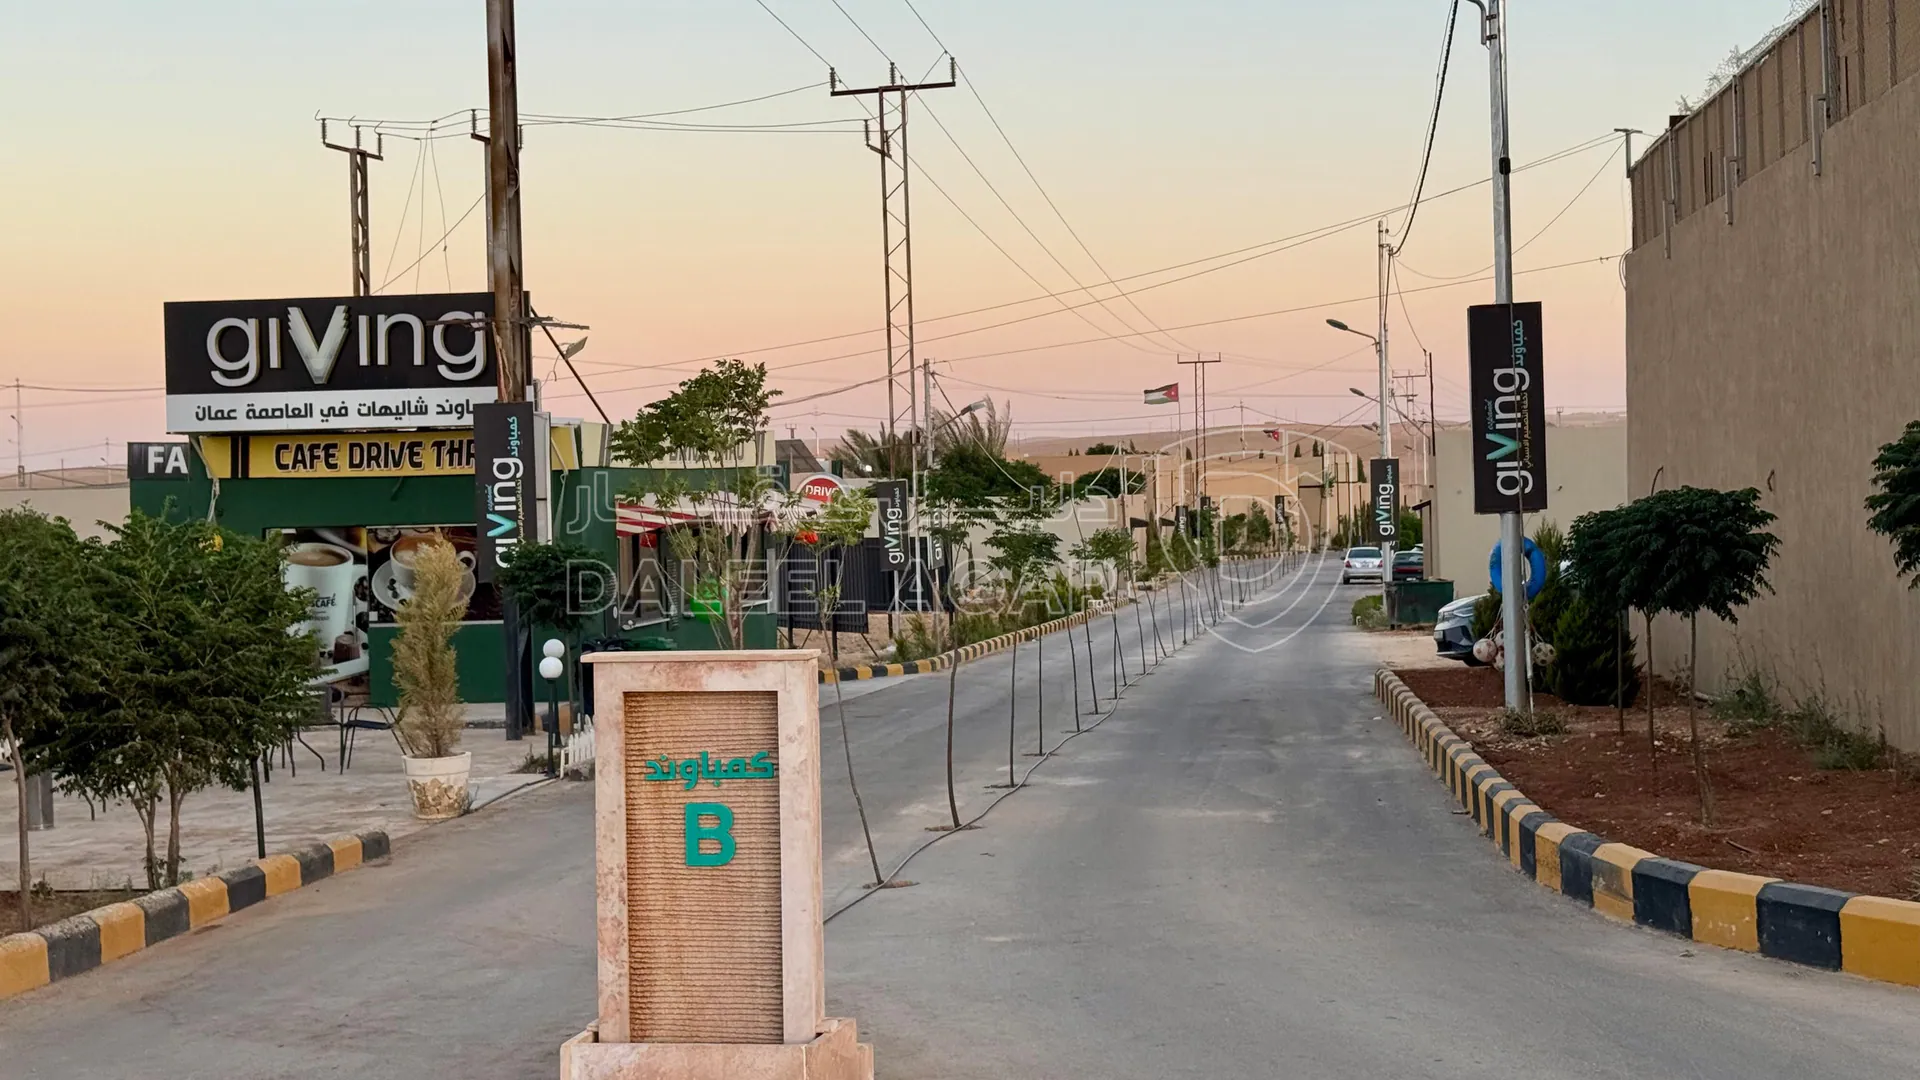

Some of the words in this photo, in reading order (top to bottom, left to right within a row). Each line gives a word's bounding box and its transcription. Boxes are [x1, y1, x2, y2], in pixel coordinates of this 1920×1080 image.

[195, 404, 237, 421] عمان
[245, 402, 313, 420] العاصمة
[320, 401, 349, 422] في
[357, 396, 428, 420] شاليهات
[508, 415, 521, 457] كمباوند
[148, 446, 189, 474] FA
[274, 442, 340, 471] CAFE
[347, 440, 424, 470] DRIVE
[430, 438, 475, 469] THR
[645, 750, 775, 790] كمباوند
[684, 802, 737, 867] B
